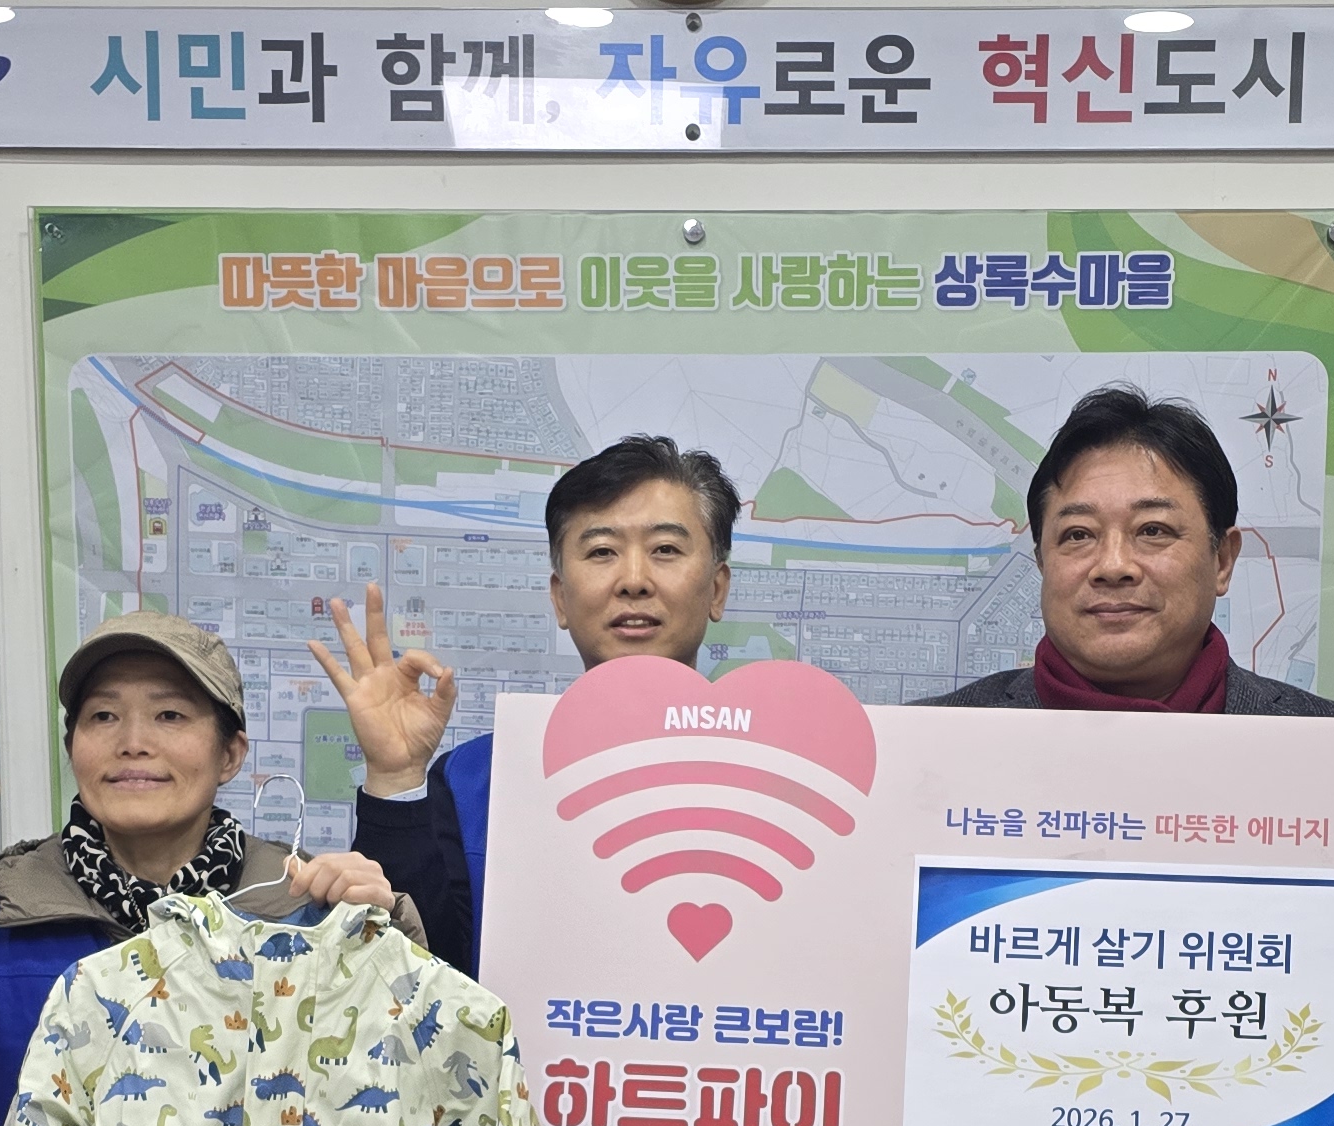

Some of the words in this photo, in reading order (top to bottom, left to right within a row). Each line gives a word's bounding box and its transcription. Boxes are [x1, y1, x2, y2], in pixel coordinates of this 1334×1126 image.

[91, 33, 338, 123] 시민과
[374, 33, 561, 125] 함께,
[595, 30, 931, 127] 자유로운
[978, 33, 1303, 125] 혁신도시
[221, 255, 361, 308] 따뜻한
[375, 255, 563, 308] 마음으로
[580, 254, 720, 309] 이웃을
[733, 254, 920, 307] 사랑하는
[935, 254, 1171, 307] 상록수마을
[1267, 368, 1277, 382] N
[1264, 455, 1273, 468] S
[665, 706, 751, 733] ANSAN
[947, 808, 1026, 837] 나눔을
[1036, 811, 1146, 840] 전파하는
[1156, 814, 1238, 844] 따뜻한
[1248, 816, 1330, 846] 에너지
[970, 924, 1079, 966] 바르게
[1092, 928, 1165, 969] 살기
[1179, 931, 1292, 973] 위원회
[547, 1000, 703, 1041] 작은사랑
[714, 1006, 843, 1047] 큰보람!
[990, 983, 1143, 1036] 아동복
[1166, 989, 1267, 1039] 후원
